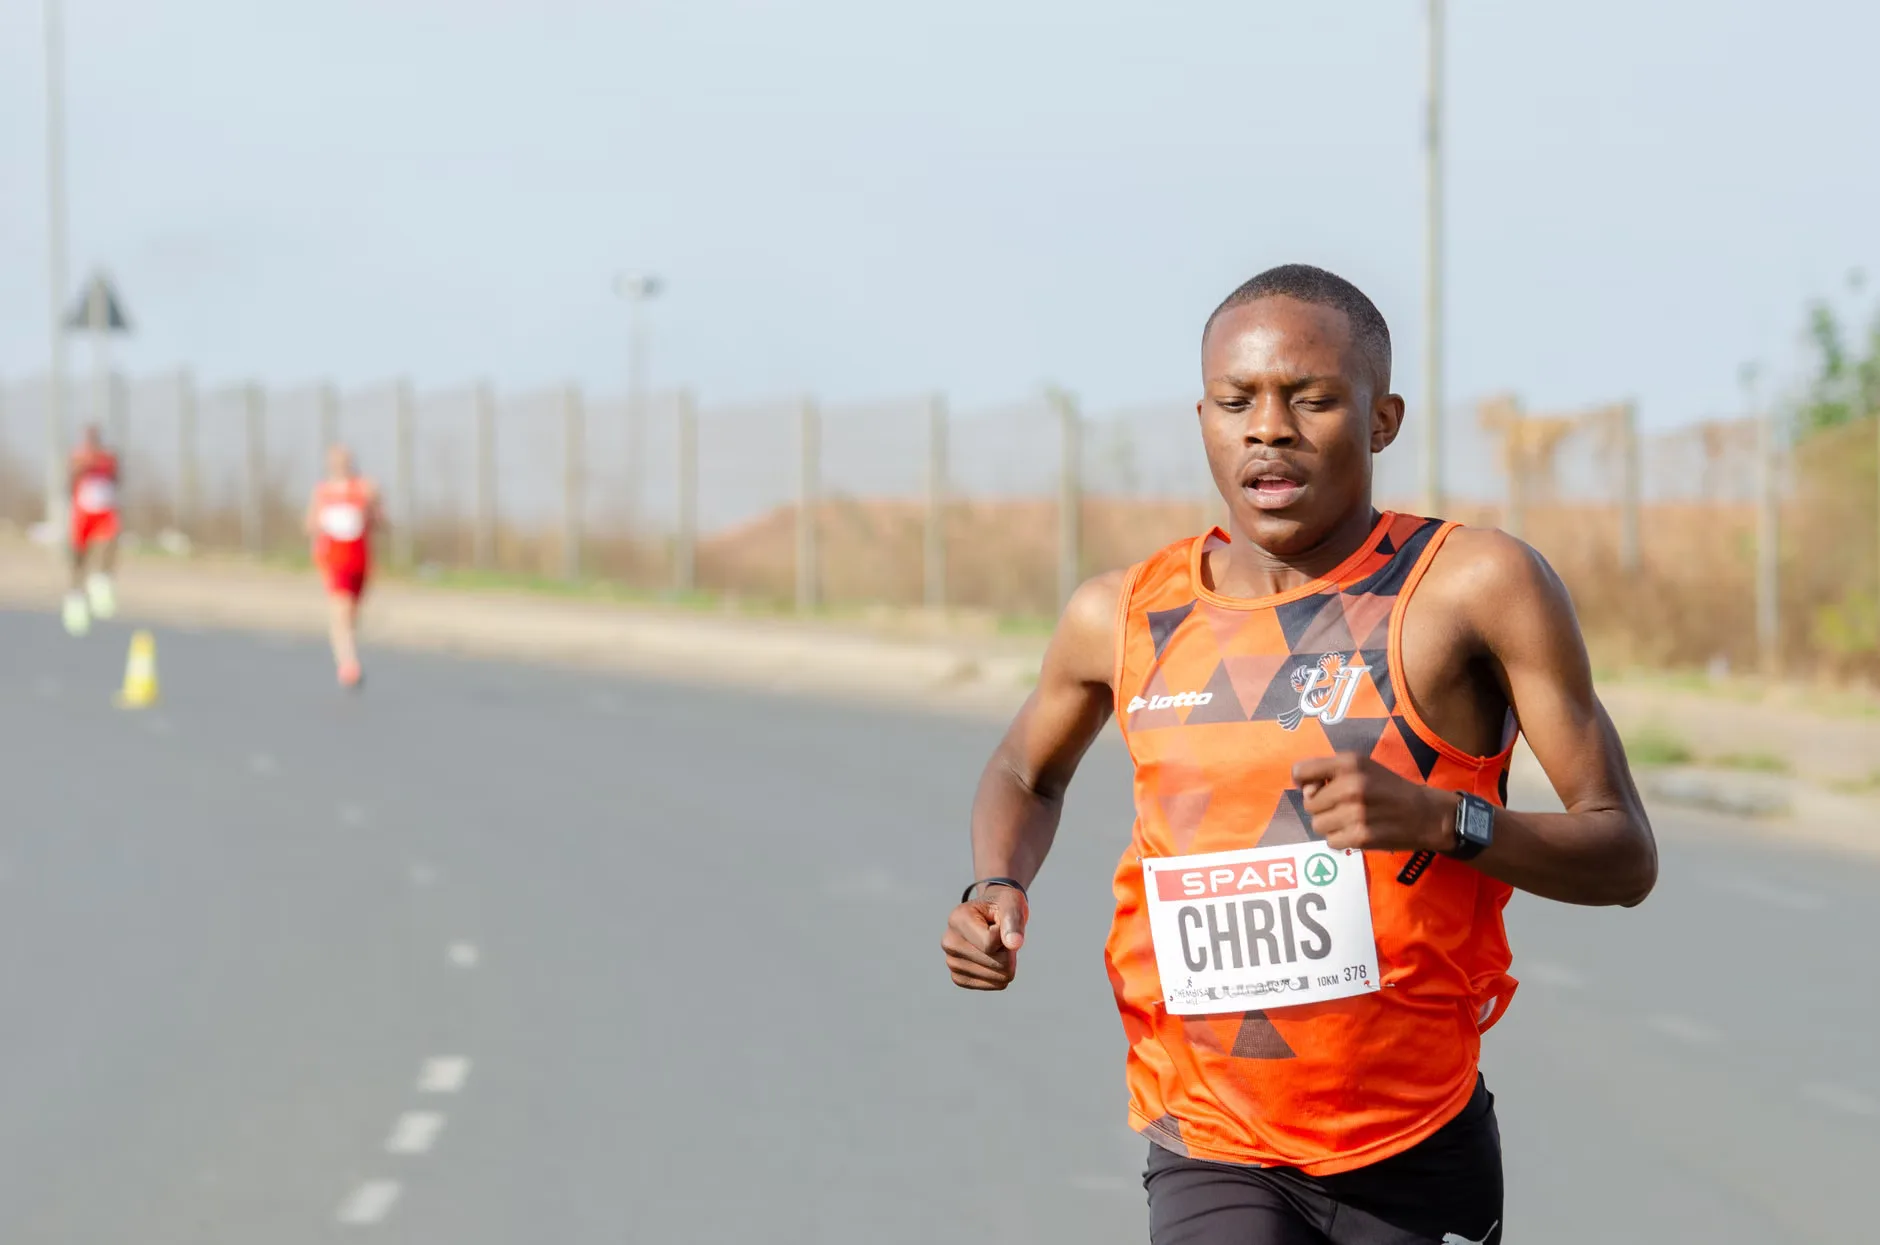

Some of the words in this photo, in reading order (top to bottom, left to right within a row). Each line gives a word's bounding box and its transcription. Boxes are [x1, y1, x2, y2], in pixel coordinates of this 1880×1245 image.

[1147, 691, 1213, 710] lotto
[1298, 664, 1373, 725] UJ
[1181, 862, 1296, 896] SPAR
[1177, 892, 1332, 973] CHRIS
[1316, 974, 1340, 987] 10KM
[1343, 964, 1368, 983] 378
